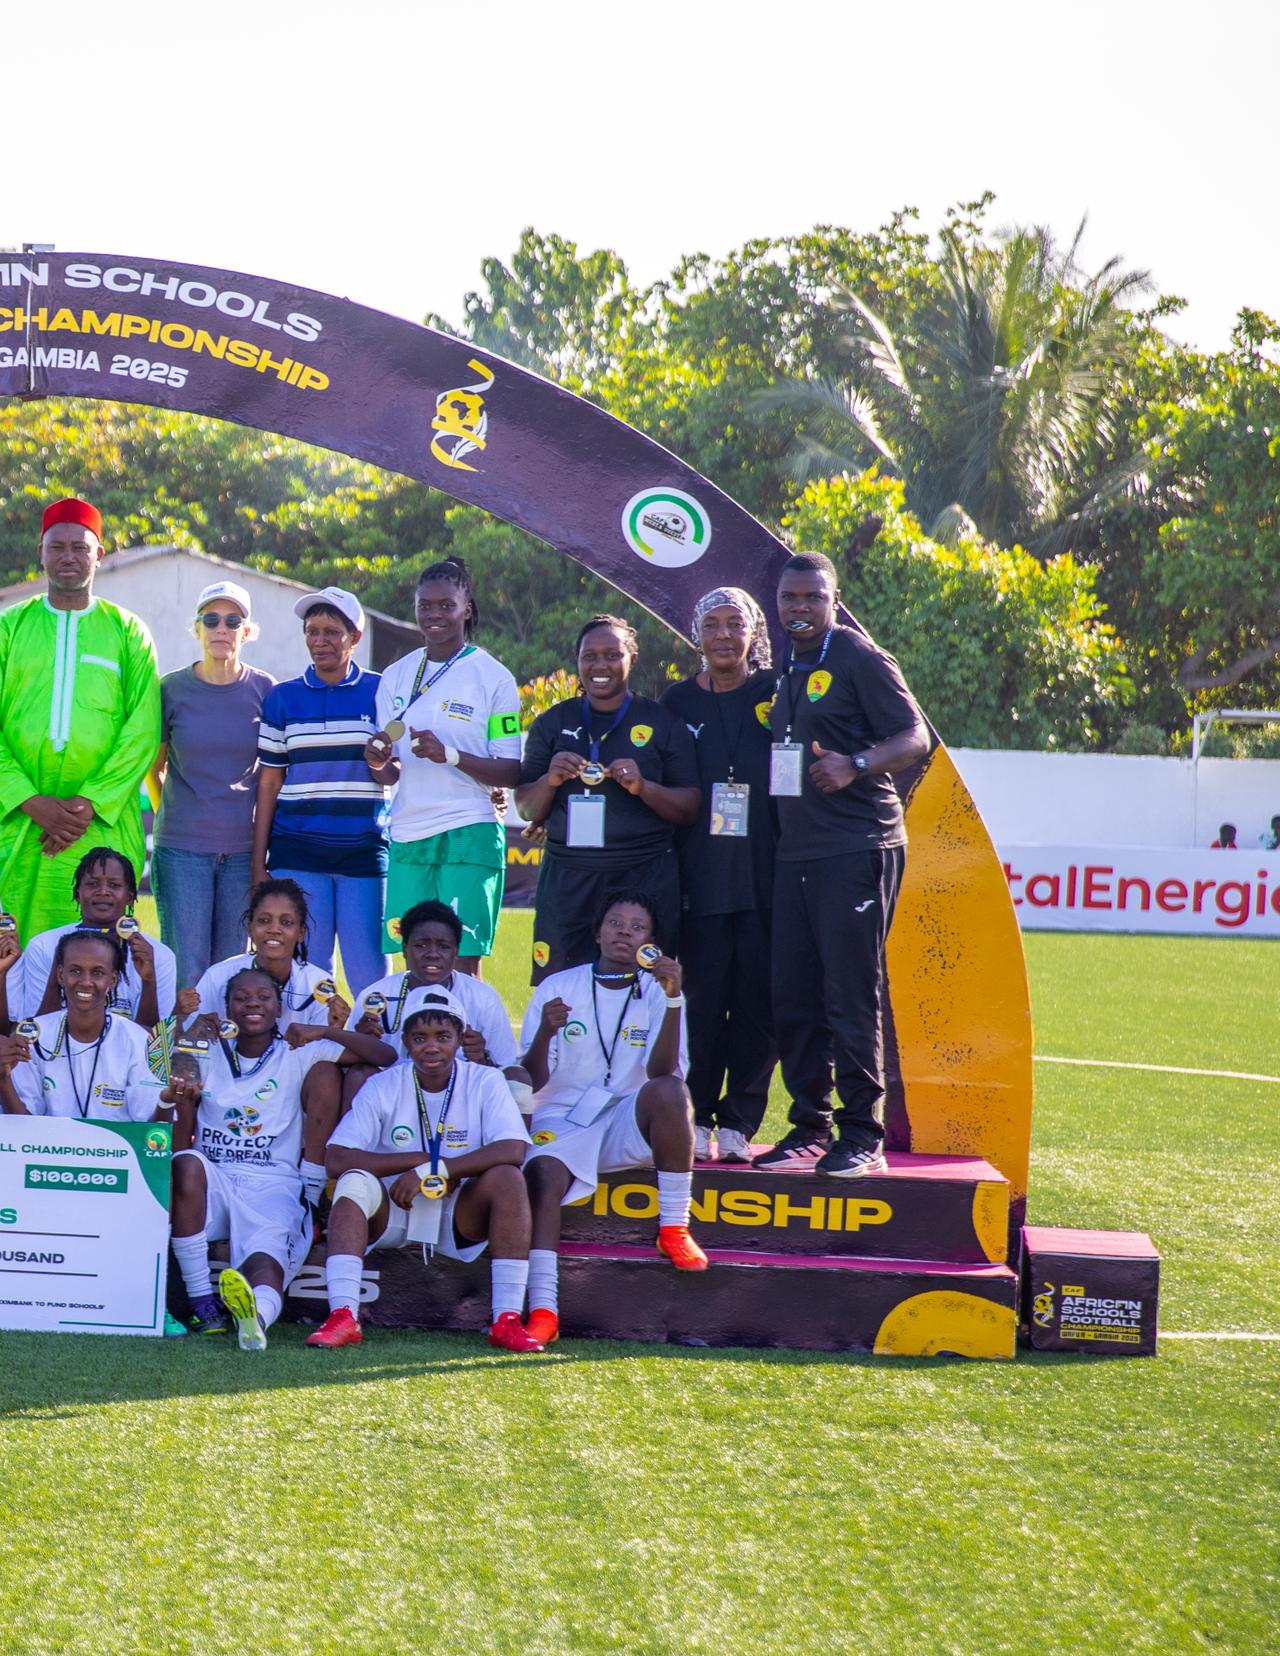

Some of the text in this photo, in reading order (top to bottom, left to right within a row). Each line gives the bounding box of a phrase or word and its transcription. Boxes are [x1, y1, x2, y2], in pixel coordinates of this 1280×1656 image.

[64, 262, 323, 342] SCHOOLS
[109, 354, 190, 389] 2025
[502, 716, 517, 735] C
[202, 1127, 278, 1149] PROTECT
[21, 1144, 129, 1159] CHAMPIONSHIP
[201, 1144, 224, 1158] THE
[29, 1169, 118, 1186] $100,000
[566, 1182, 893, 1232] IONSHIP
[1062, 1296, 1141, 1310] AFRICAN
[1061, 1305, 1141, 1319] SCHOOLS
[1060, 1314, 1141, 1328] FOOTBALL
[1060, 1323, 1140, 1334] CHAMPIONSHIP
